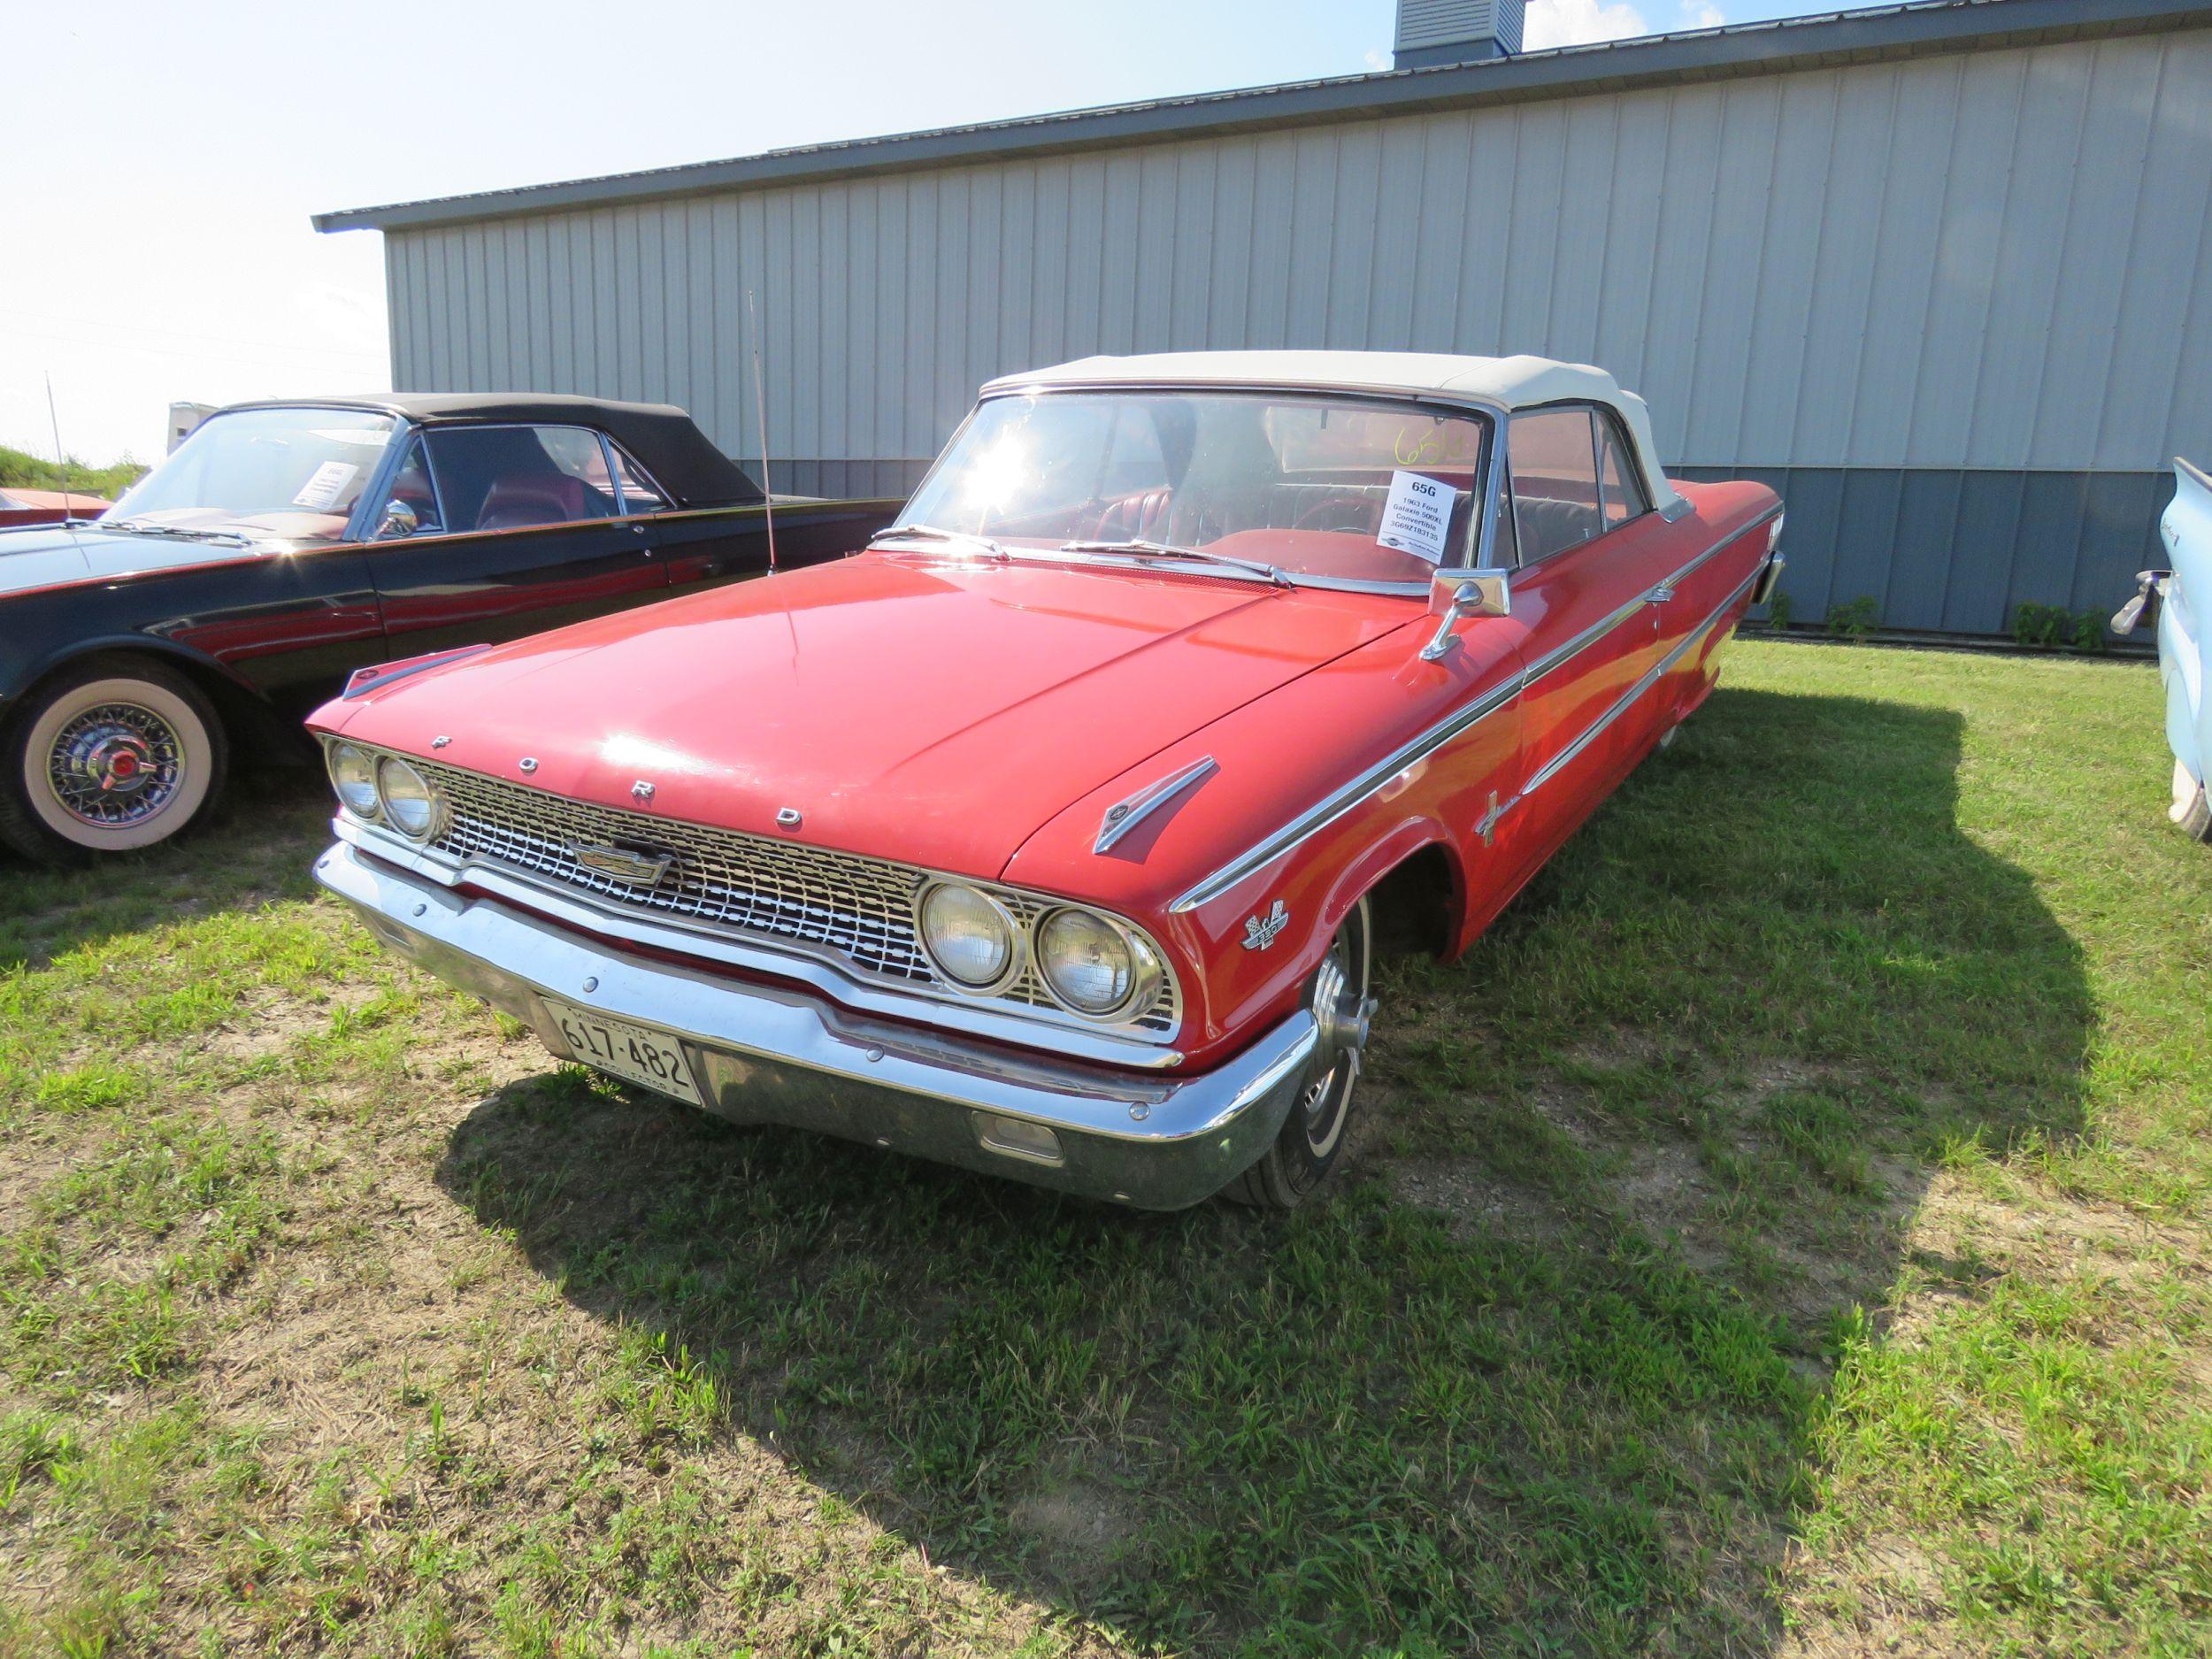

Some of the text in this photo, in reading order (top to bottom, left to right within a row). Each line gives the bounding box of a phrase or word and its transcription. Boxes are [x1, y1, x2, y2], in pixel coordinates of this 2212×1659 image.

[1411, 481, 1436, 497] 65G
[1403, 497, 1439, 513] 1963 Ford
[1393, 503, 1442, 525] Galaxie 500XL
[1395, 513, 1437, 531] Convertible
[1258, 926, 1278, 941] 390
[572, 1011, 648, 1041] MINNESOTA
